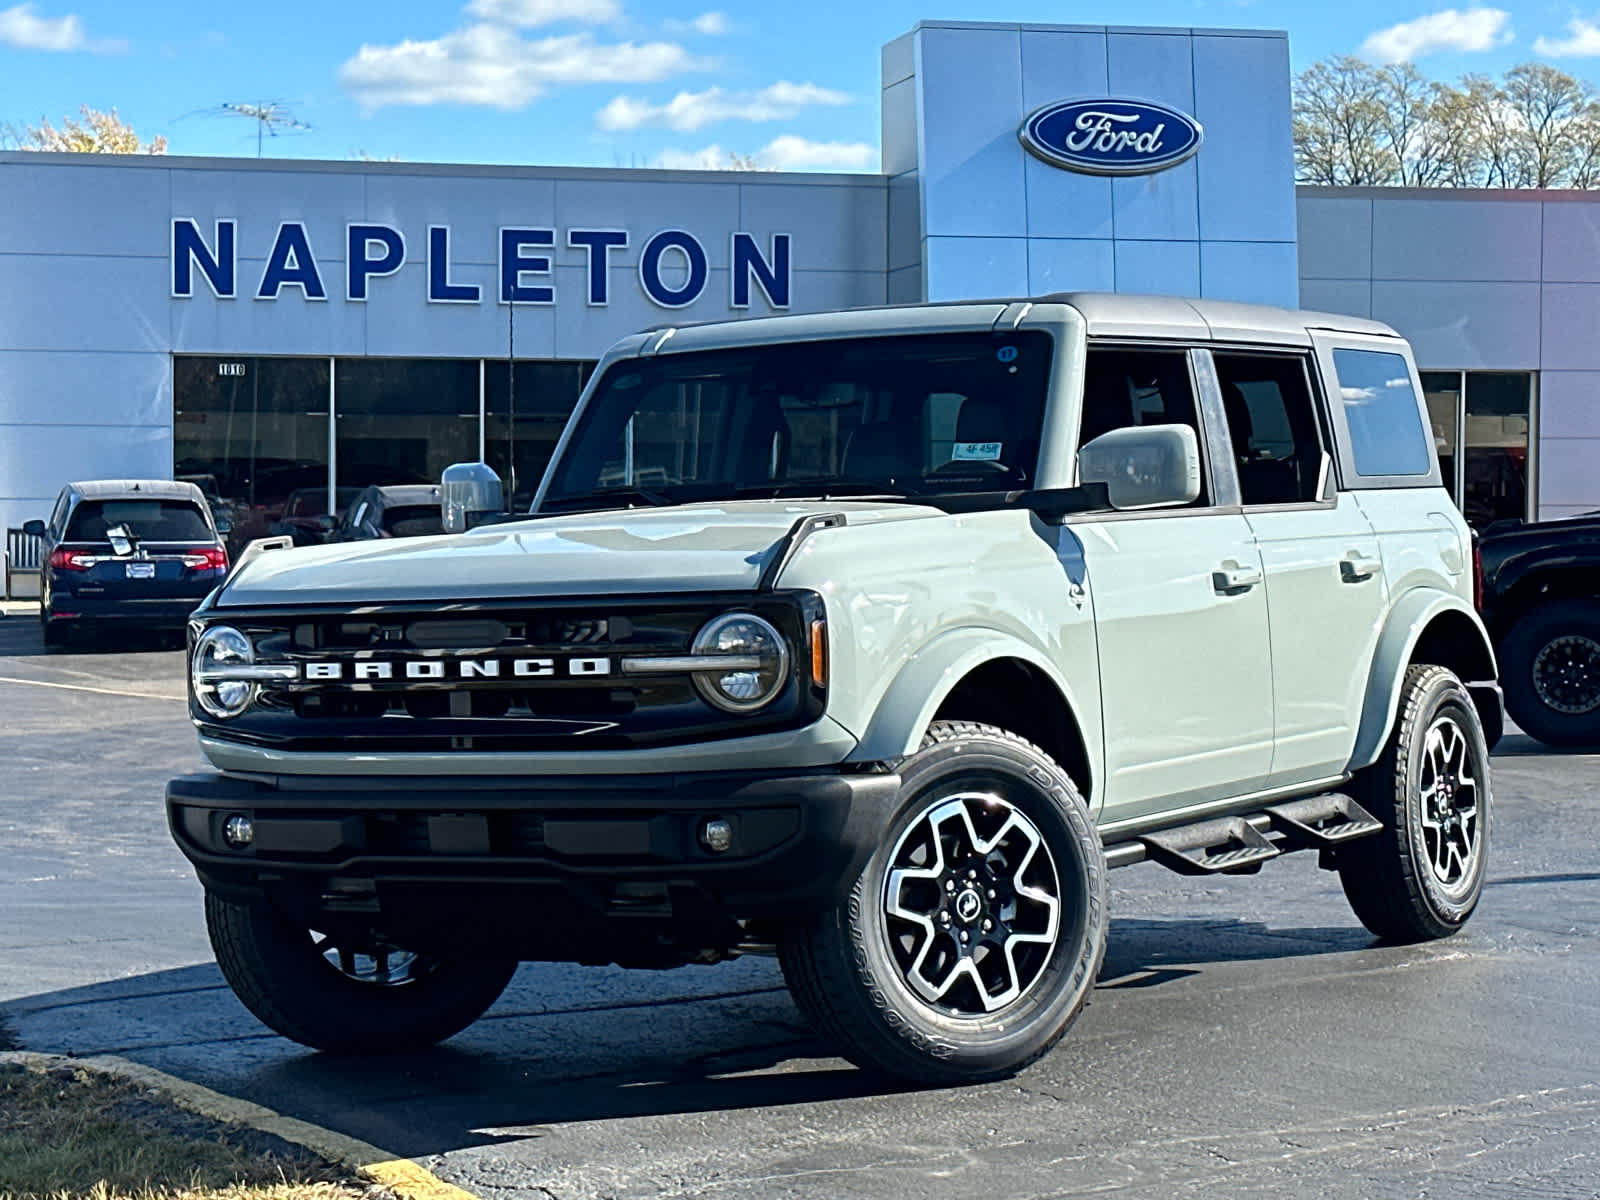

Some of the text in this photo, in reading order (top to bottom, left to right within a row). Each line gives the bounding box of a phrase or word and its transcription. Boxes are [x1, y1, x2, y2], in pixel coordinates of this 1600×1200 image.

[1065, 111, 1165, 153] Ford
[170, 217, 792, 308] NAPLETON
[305, 657, 611, 680] BRONCO
